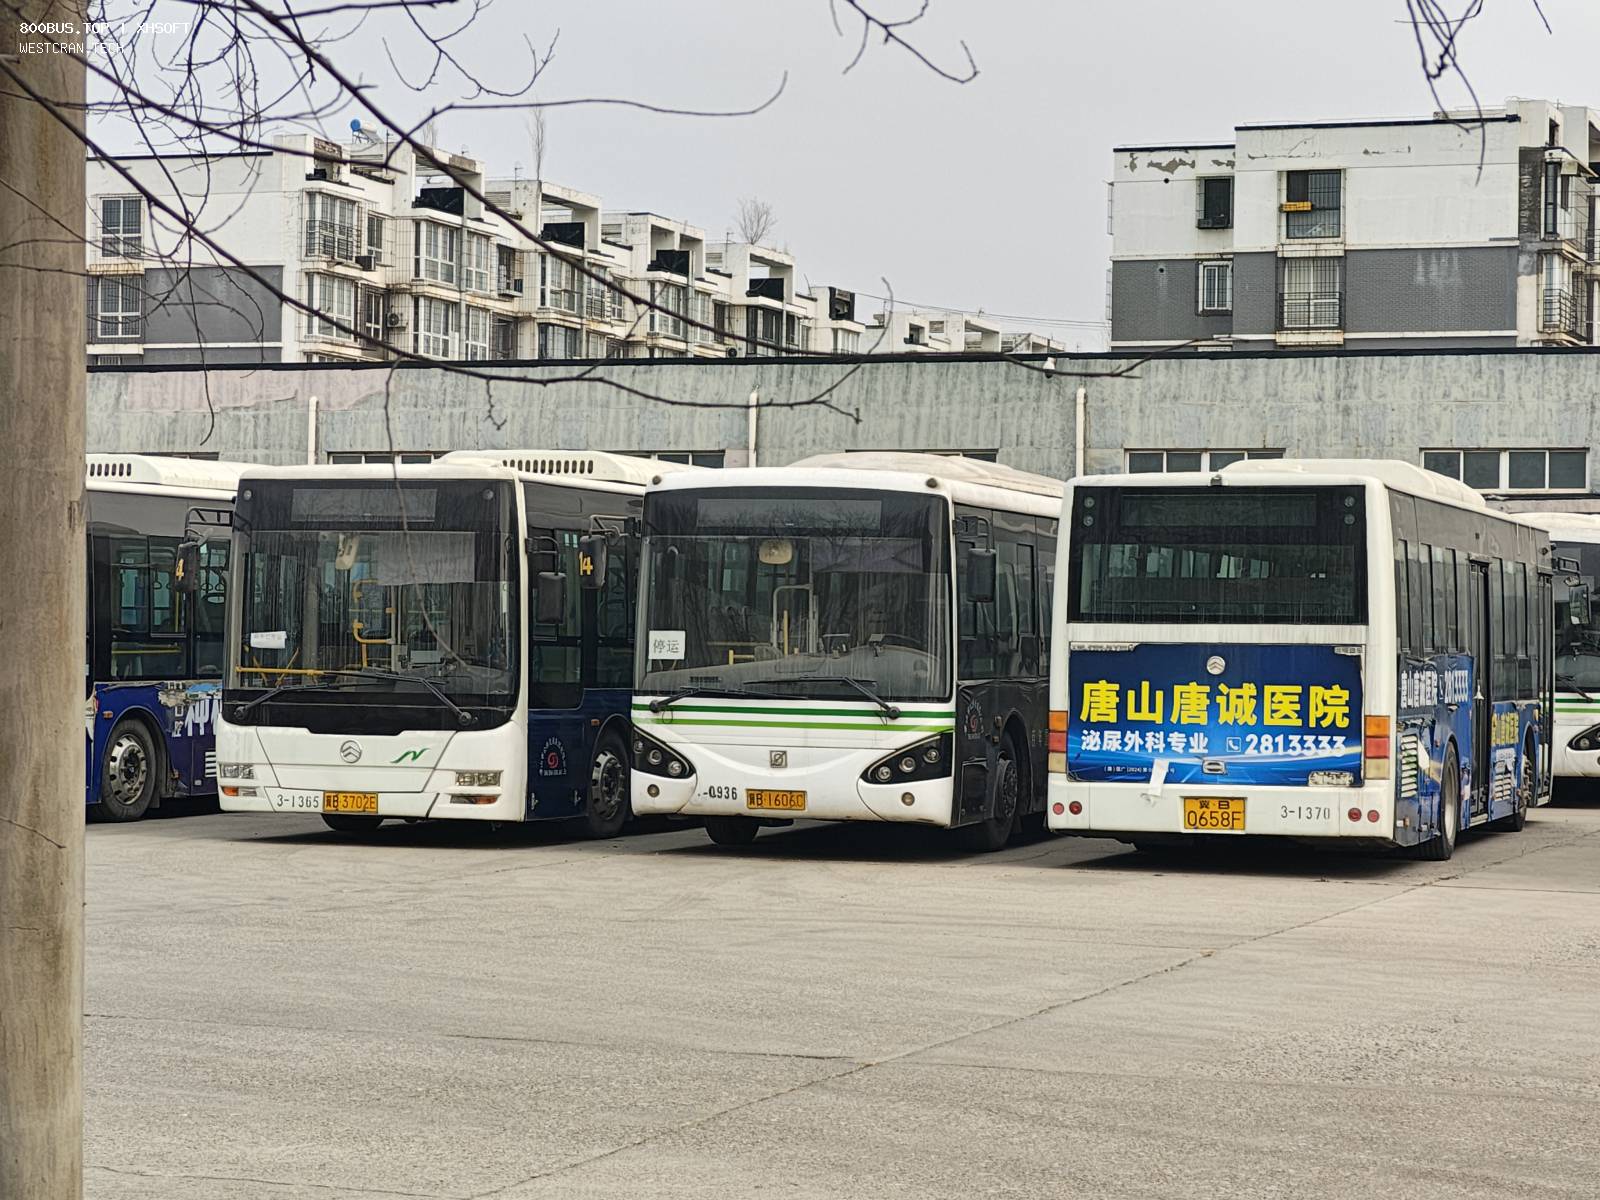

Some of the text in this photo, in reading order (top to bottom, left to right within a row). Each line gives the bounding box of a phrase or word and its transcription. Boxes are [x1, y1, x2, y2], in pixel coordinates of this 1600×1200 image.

[578, 551, 594, 576] 14
[1080, 680, 1350, 728] 唐山唐诚医院
[1080, 729, 1209, 754] 泌尿外科专业
[1244, 733, 1347, 757] 2813333
[276, 794, 320, 809] 3-1365
[1280, 805, 1331, 820] 3-1370
[1186, 810, 1243, 828] 0658F
